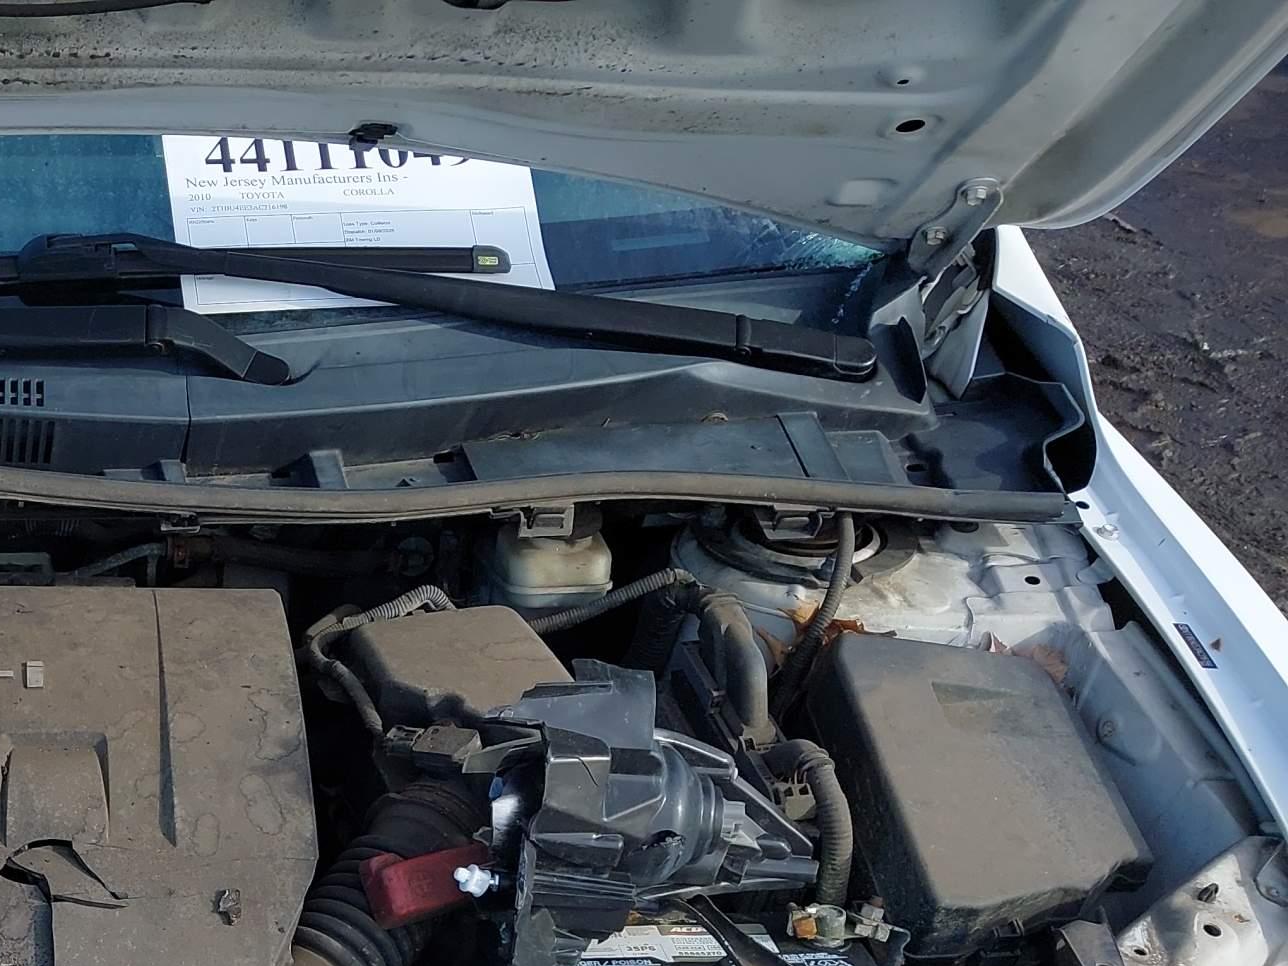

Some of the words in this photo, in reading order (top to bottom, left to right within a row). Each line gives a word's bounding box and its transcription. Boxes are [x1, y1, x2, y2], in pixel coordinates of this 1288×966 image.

[186, 177, 218, 189] New
[223, 175, 267, 188] Jersey
[271, 173, 373, 186] Manufacturers
[377, 172, 399, 184] Ins
[188, 193, 212, 201] 2010
[241, 191, 285, 200] TOYOTA
[343, 187, 394, 197] COROLLA
